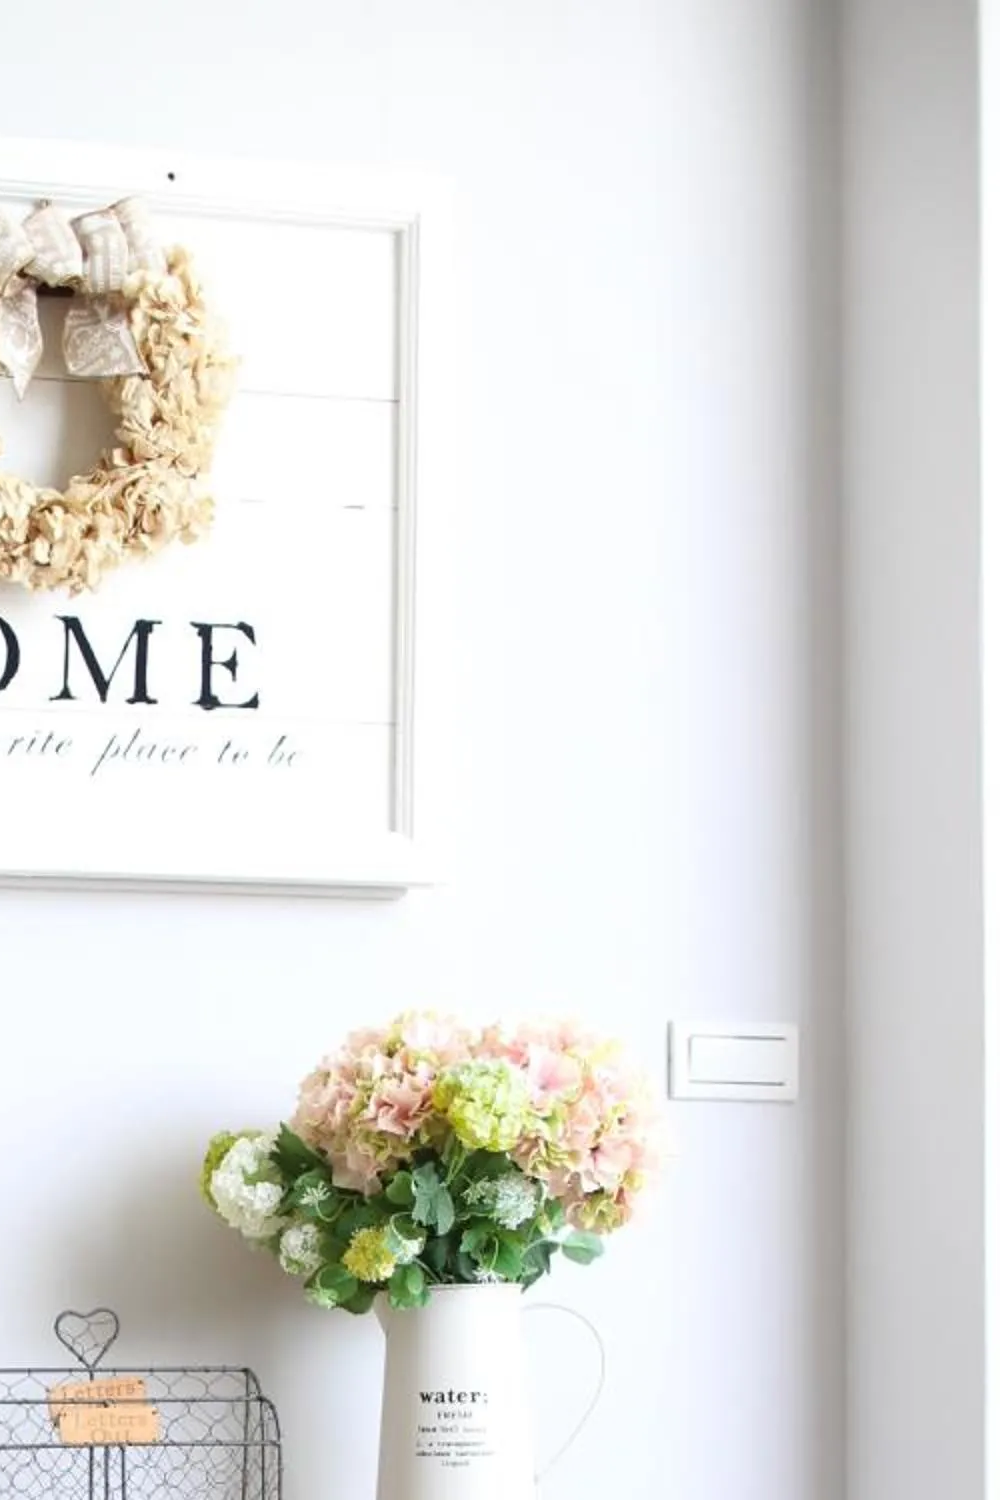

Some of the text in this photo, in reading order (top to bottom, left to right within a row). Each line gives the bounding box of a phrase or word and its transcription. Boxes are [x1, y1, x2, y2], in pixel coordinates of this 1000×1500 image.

[90, 727, 198, 777] place
[217, 739, 249, 764] to
[267, 734, 297, 767] be
